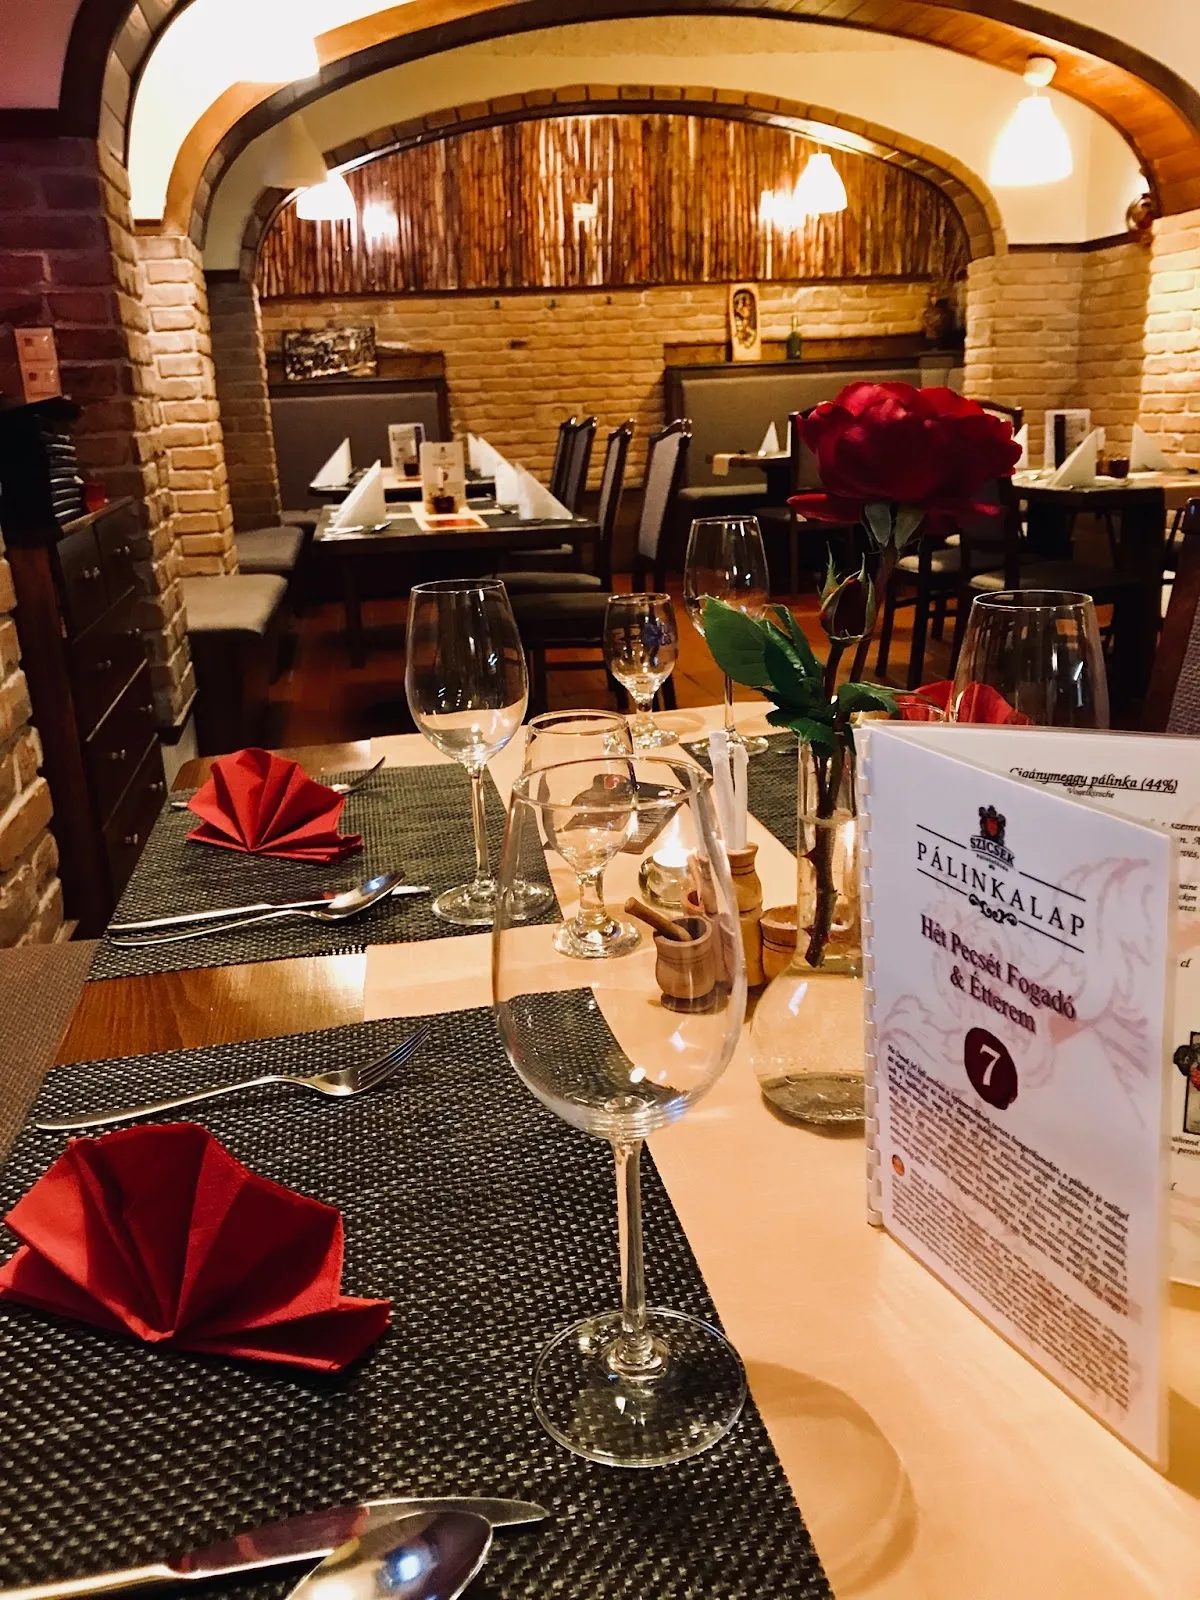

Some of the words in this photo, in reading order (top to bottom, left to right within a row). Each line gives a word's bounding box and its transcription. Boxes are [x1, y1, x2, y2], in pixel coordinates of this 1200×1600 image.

[1090, 773, 1138, 789] pálinka
[1140, 777, 1179, 793] (44%)
[969, 837, 1016, 867] SZICSEK
[917, 841, 1086, 937] PÁLINKALAP
[920, 913, 948, 948] Hét
[950, 931, 1002, 979] Pecsét
[1006, 962, 1078, 1022] Fogadó
[950, 965, 967, 993] &
[969, 971, 1037, 1034] Étterem
[979, 1043, 1001, 1087] 7
